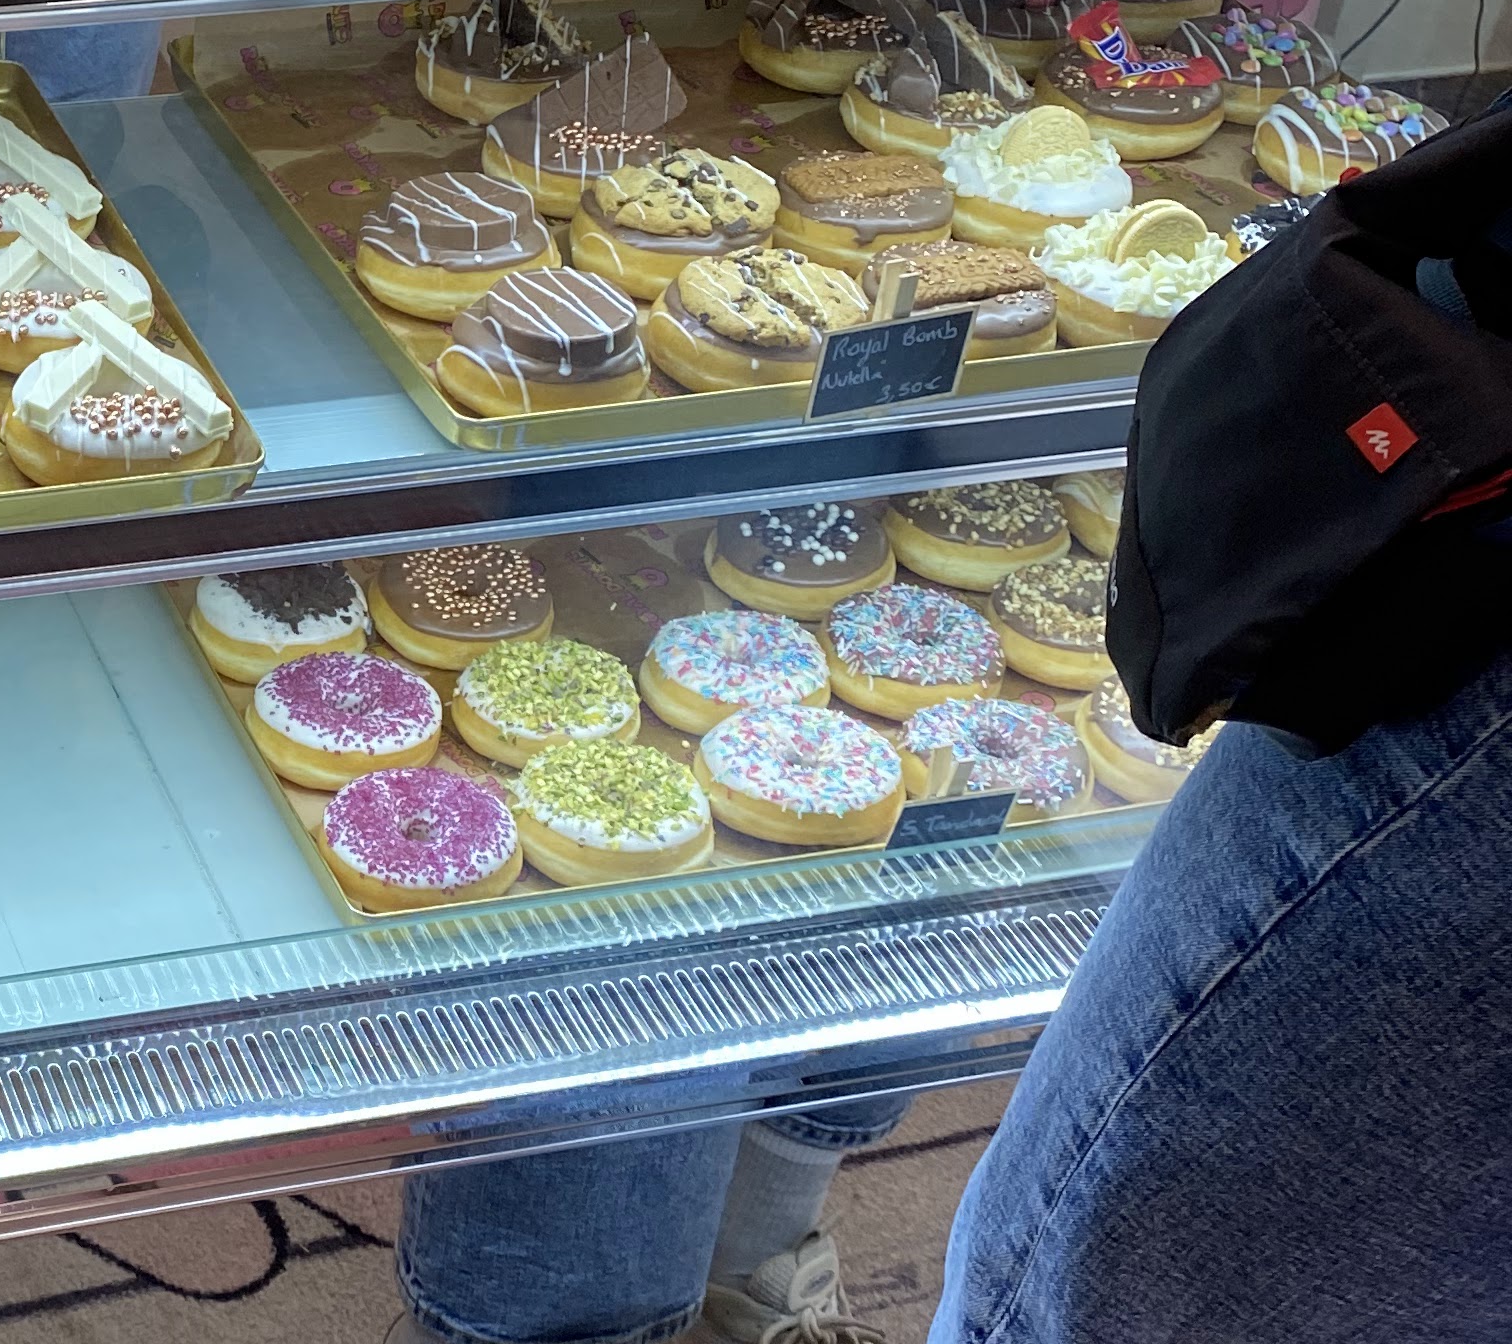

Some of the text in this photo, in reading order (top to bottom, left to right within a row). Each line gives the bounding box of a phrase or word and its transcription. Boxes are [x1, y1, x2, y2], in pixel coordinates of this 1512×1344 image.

[832, 320, 958, 367] Royal Bomb
[875, 375, 943, 404] 3,50€
